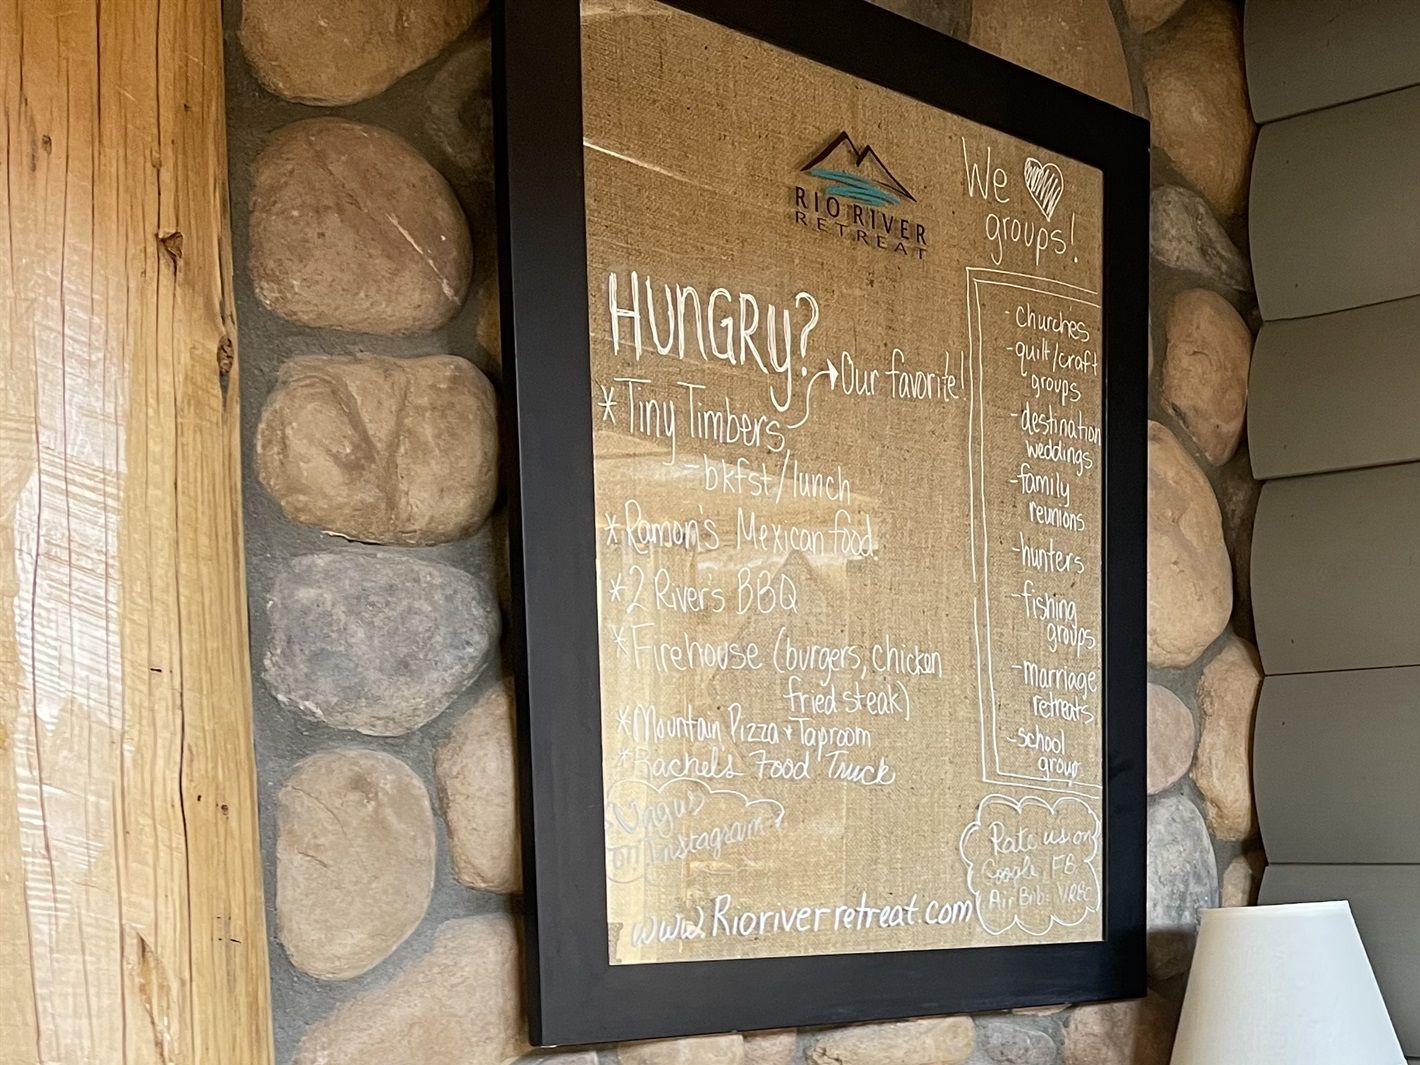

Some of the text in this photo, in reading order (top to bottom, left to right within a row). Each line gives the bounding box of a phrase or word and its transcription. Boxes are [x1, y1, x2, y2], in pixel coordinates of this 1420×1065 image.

[961, 136, 1010, 204] We
[795, 186, 927, 246] RIO RIVER
[795, 211, 927, 260] RETREAT
[985, 212, 1079, 266] groups!
[841, 349, 967, 402] Our favorite!
[1015, 337, 1099, 378] quilt/craft
[1031, 374, 1082, 407] groups
[613, 377, 786, 466] Tiny Timbers
[1021, 401, 1102, 447] destination
[1025, 439, 1093, 479] weddings
[1017, 463, 1070, 507] family
[624, 498, 720, 556] Ramon's
[736, 506, 825, 557] Mexican
[1028, 500, 1086, 532] reunions
[1019, 531, 1086, 574] hunters
[626, 564, 649, 615] 2
[736, 567, 799, 615] BBQ
[1020, 580, 1079, 626] fishing
[631, 622, 943, 688] Firehouse (burgers, chicken
[1046, 621, 1097, 659] groups
[783, 675, 911, 722] fried steak)
[1032, 691, 1096, 725] retreats
[633, 703, 721, 744] Mountain
[727, 702, 779, 745] Pizza
[788, 716, 872, 762] Taproom
[749, 749, 812, 781] Food
[825, 750, 897, 786] Truck
[988, 821, 1038, 856] Rate
[1043, 828, 1070, 845] us
